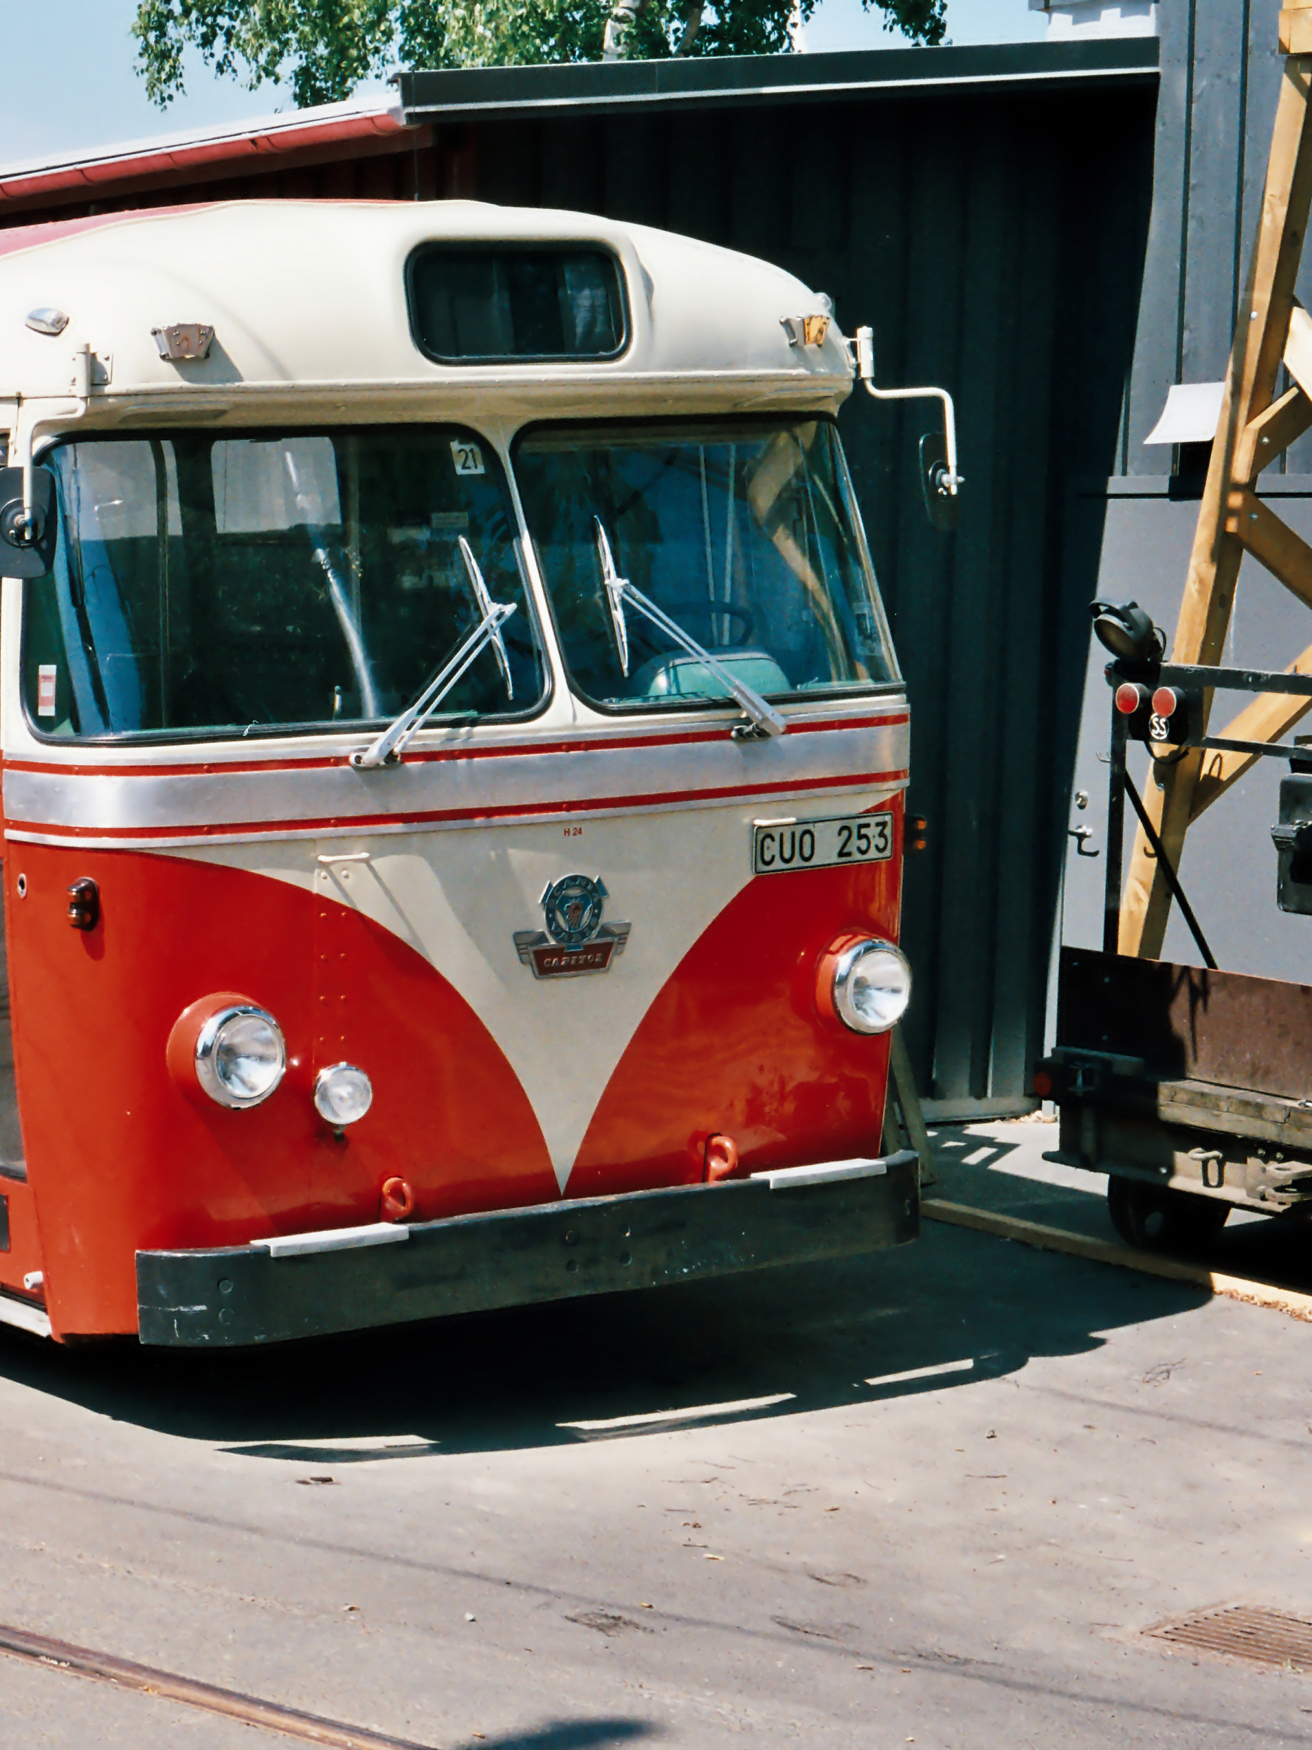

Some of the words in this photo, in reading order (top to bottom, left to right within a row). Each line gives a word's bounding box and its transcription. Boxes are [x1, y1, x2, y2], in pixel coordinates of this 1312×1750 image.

[457, 447, 478, 470] 21
[563, 827, 571, 837] H
[572, 826, 583, 837] 24
[760, 829, 816, 867] CUO
[837, 820, 889, 858] 253
